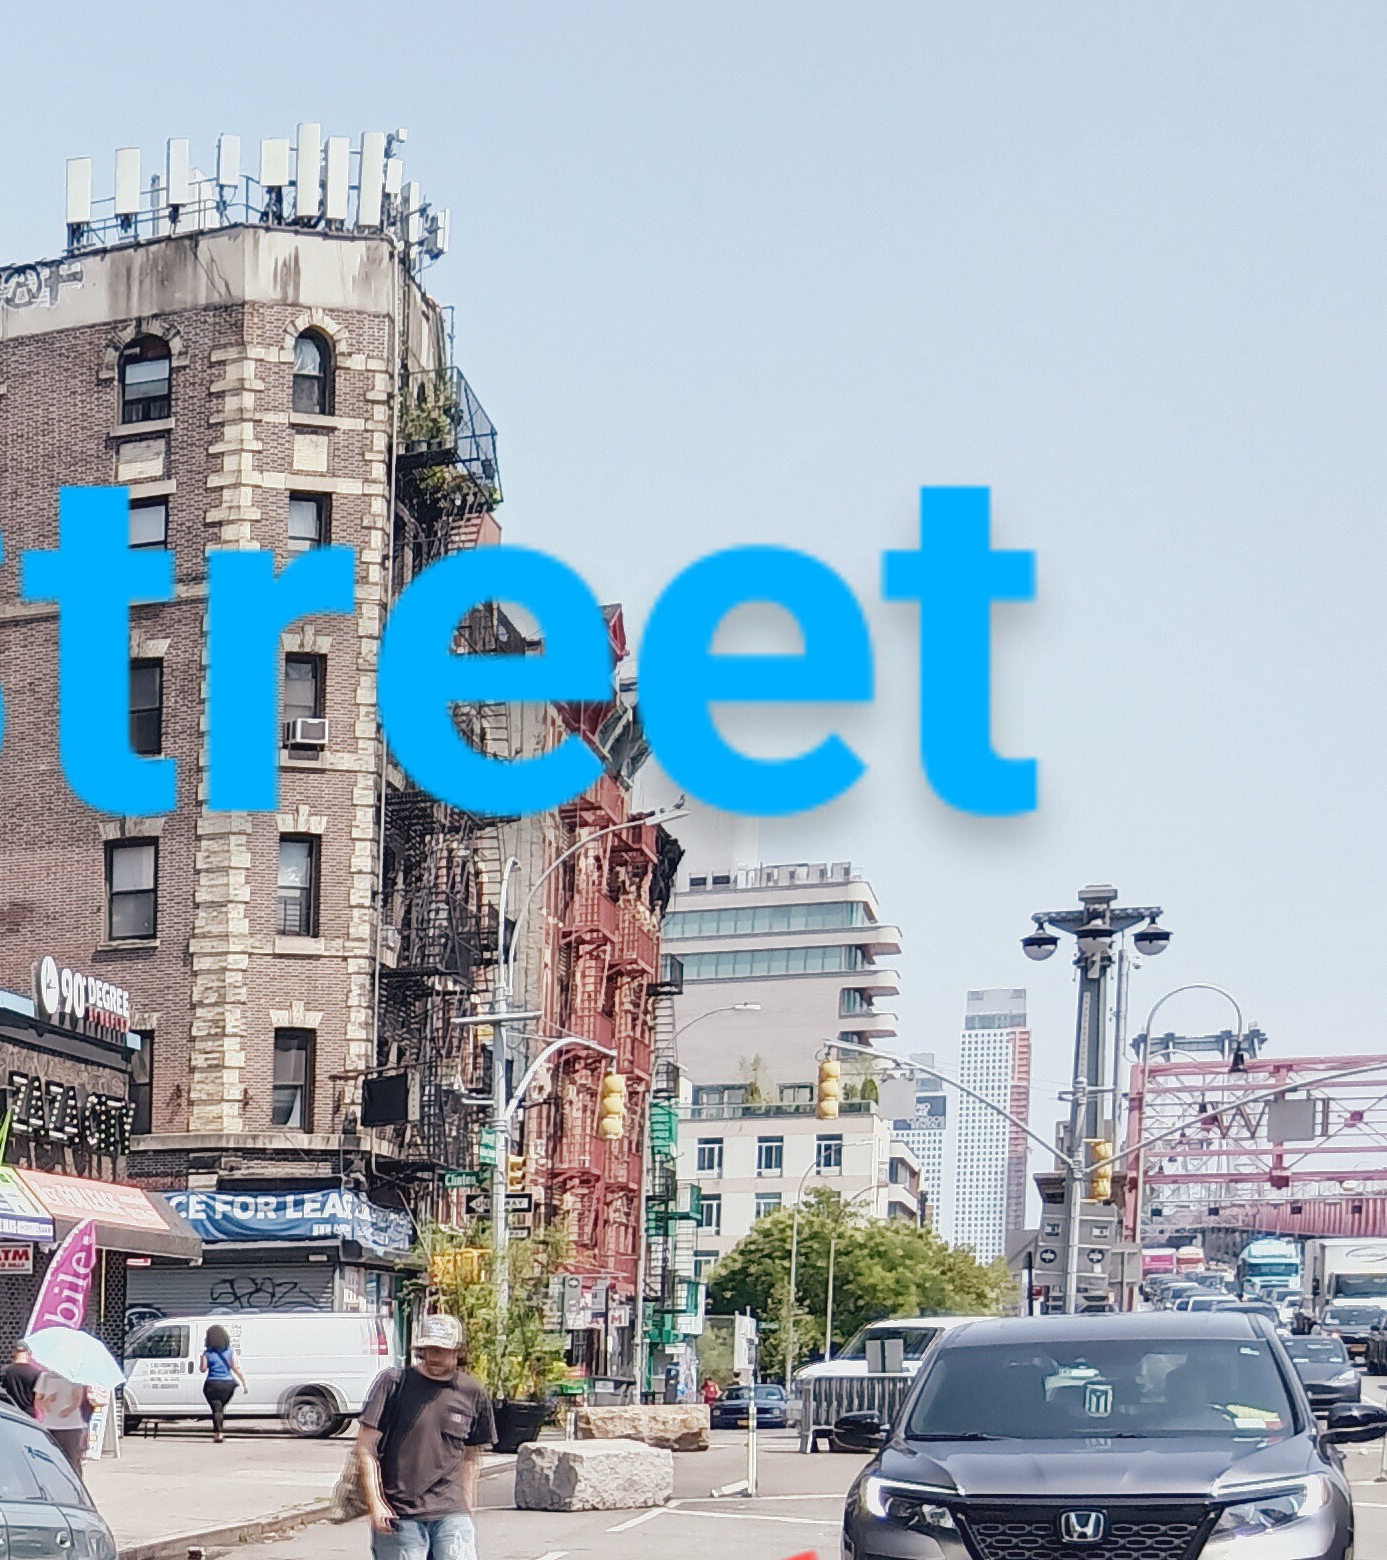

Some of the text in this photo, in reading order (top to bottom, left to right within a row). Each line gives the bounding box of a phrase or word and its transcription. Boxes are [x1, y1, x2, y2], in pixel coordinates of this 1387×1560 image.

[88, 976, 129, 1018] DEGREE
[444, 1173, 478, 1187] Clinton
[214, 1196, 277, 1220] FOR
